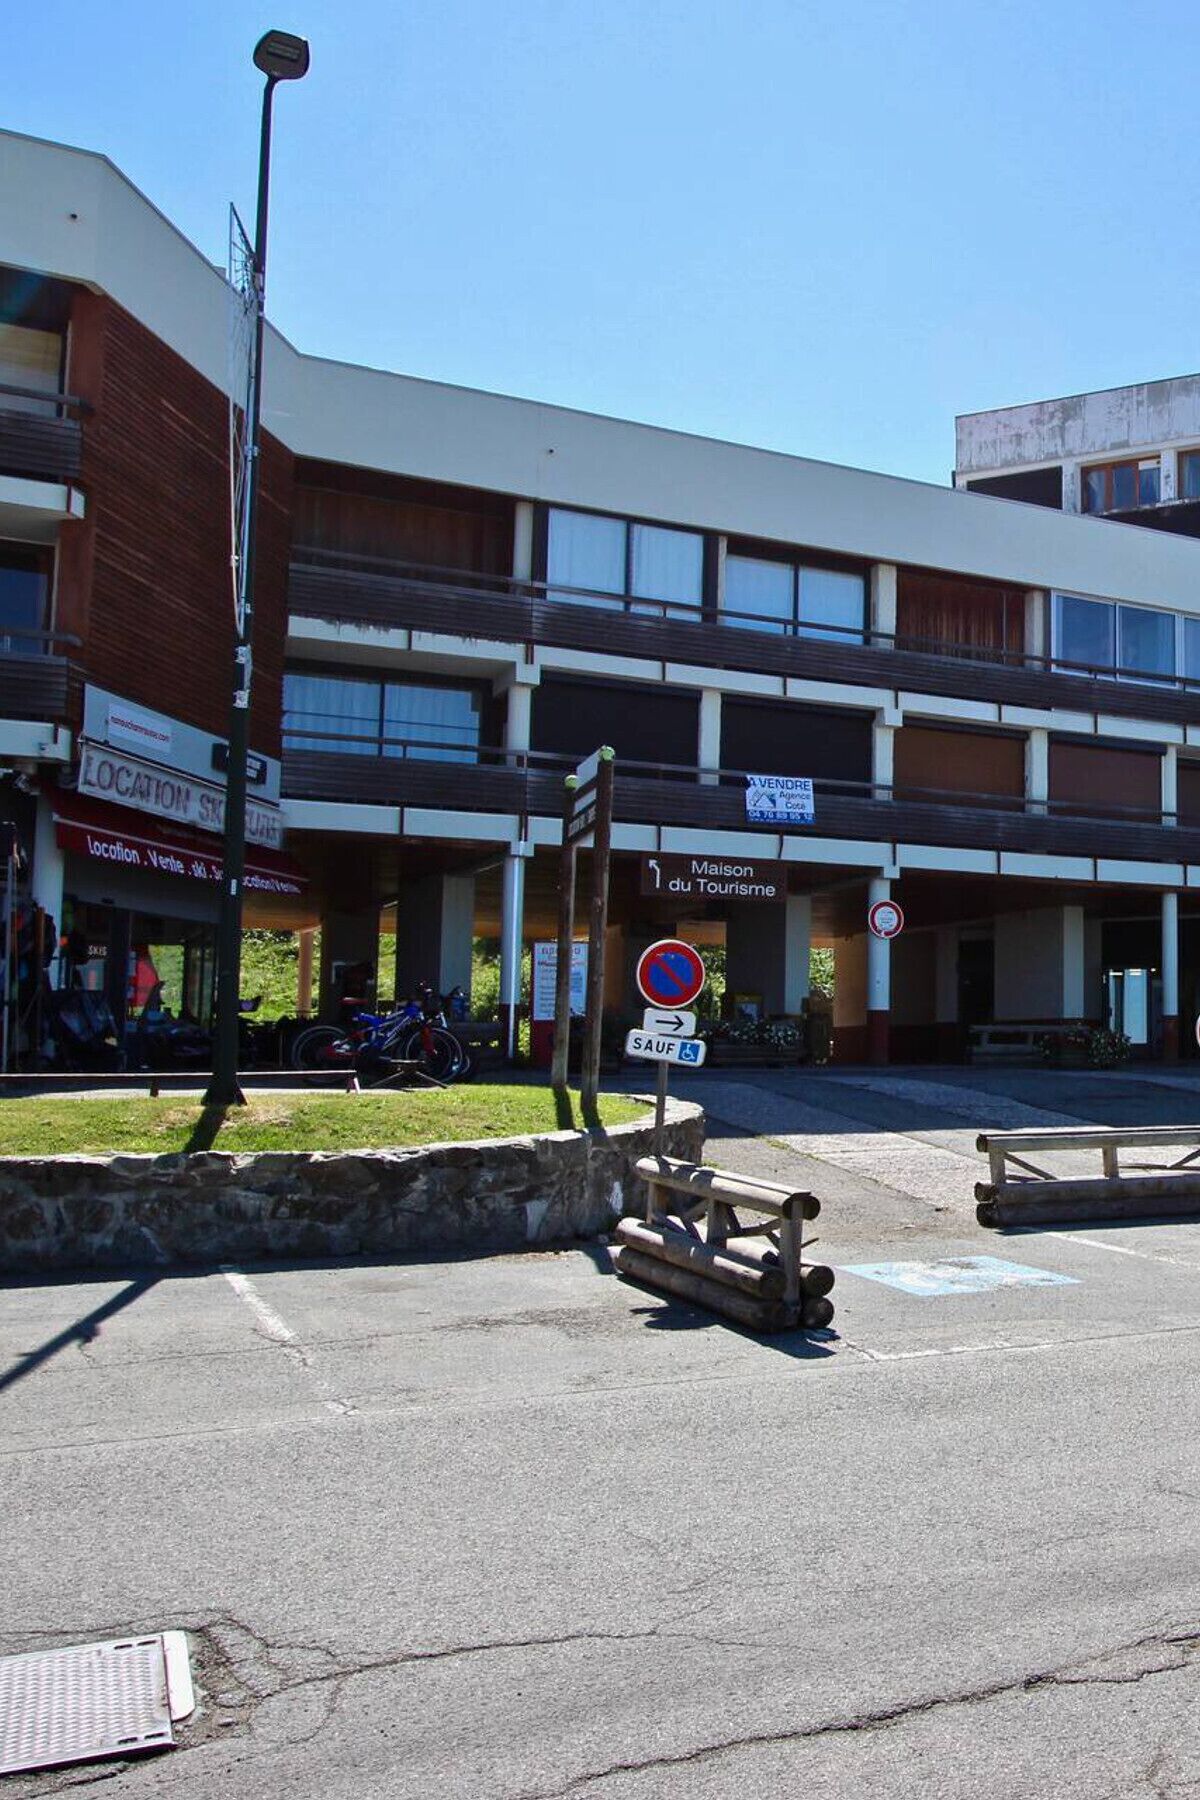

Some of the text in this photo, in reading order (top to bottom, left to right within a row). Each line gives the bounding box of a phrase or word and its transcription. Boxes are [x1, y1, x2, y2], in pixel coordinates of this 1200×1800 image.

[83, 755, 191, 815] LOCATION
[758, 778, 811, 791] VENDRE
[87, 835, 140, 864] Location
[147, 849, 185, 874] Vente
[691, 860, 753, 877] Maison
[669, 878, 775, 897] du Tourisme
[633, 1037, 676, 1055] SAUF
